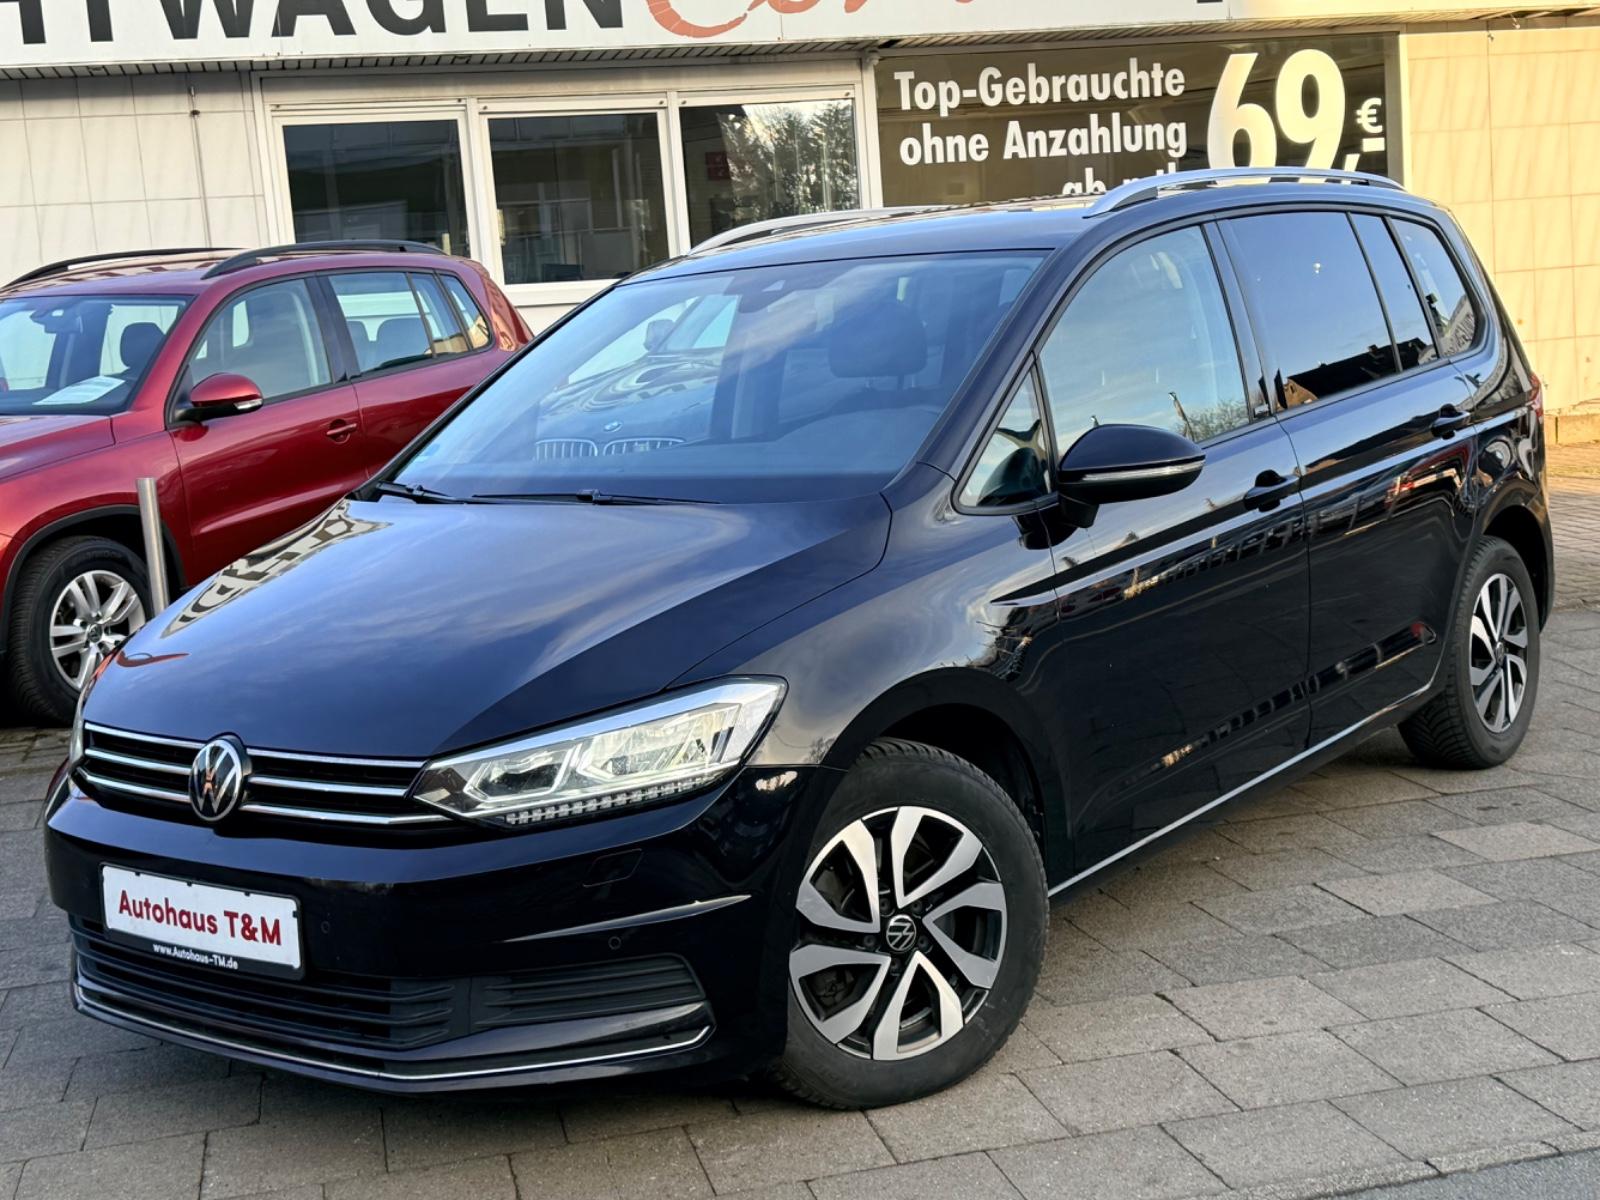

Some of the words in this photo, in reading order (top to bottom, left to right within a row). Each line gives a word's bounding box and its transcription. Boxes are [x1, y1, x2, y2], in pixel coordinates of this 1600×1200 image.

[894, 57, 1186, 117] Top-Gebrauchte
[899, 122, 990, 166] ohne
[1003, 112, 1188, 158] Anzahlung
[118, 889, 219, 935] Autohaus
[223, 910, 282, 946] T&M
[152, 943, 239, 970] www.Autohaus-TM.de
